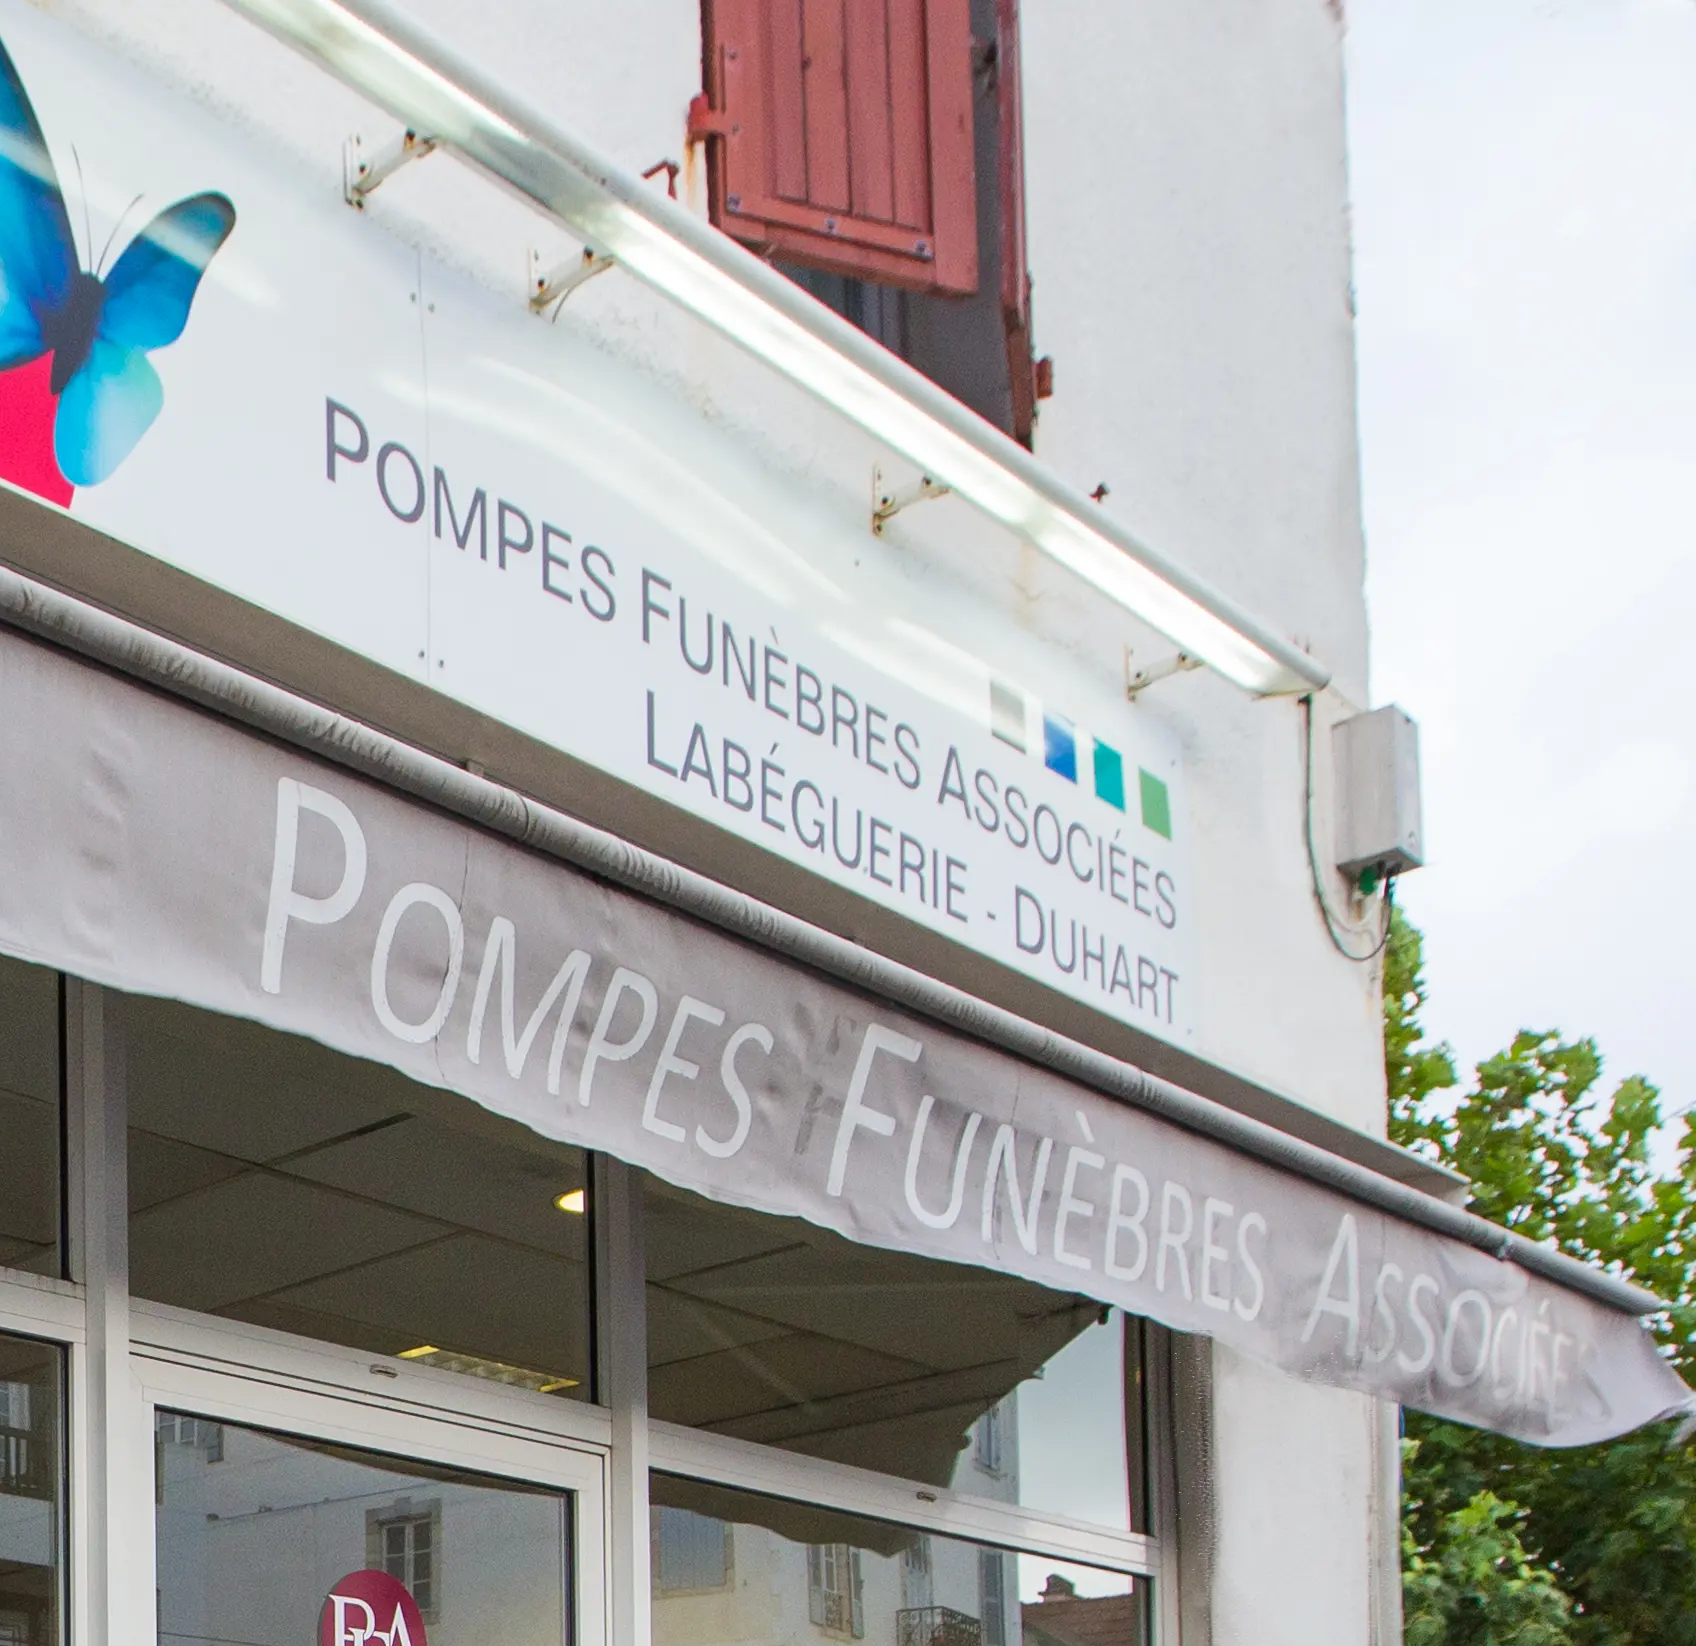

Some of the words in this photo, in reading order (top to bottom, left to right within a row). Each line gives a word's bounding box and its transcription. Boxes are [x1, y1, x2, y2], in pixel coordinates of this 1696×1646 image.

[325, 397, 616, 622] POMPES
[642, 567, 921, 791] FUNÈBRES
[939, 746, 1178, 929] ASSOCIÉES
[646, 690, 969, 922] LABÉGUERIE
[1014, 885, 1179, 1025] DUHART
[260, 777, 774, 1158] POMPES
[827, 1022, 1268, 1321] FUNÈBRES
